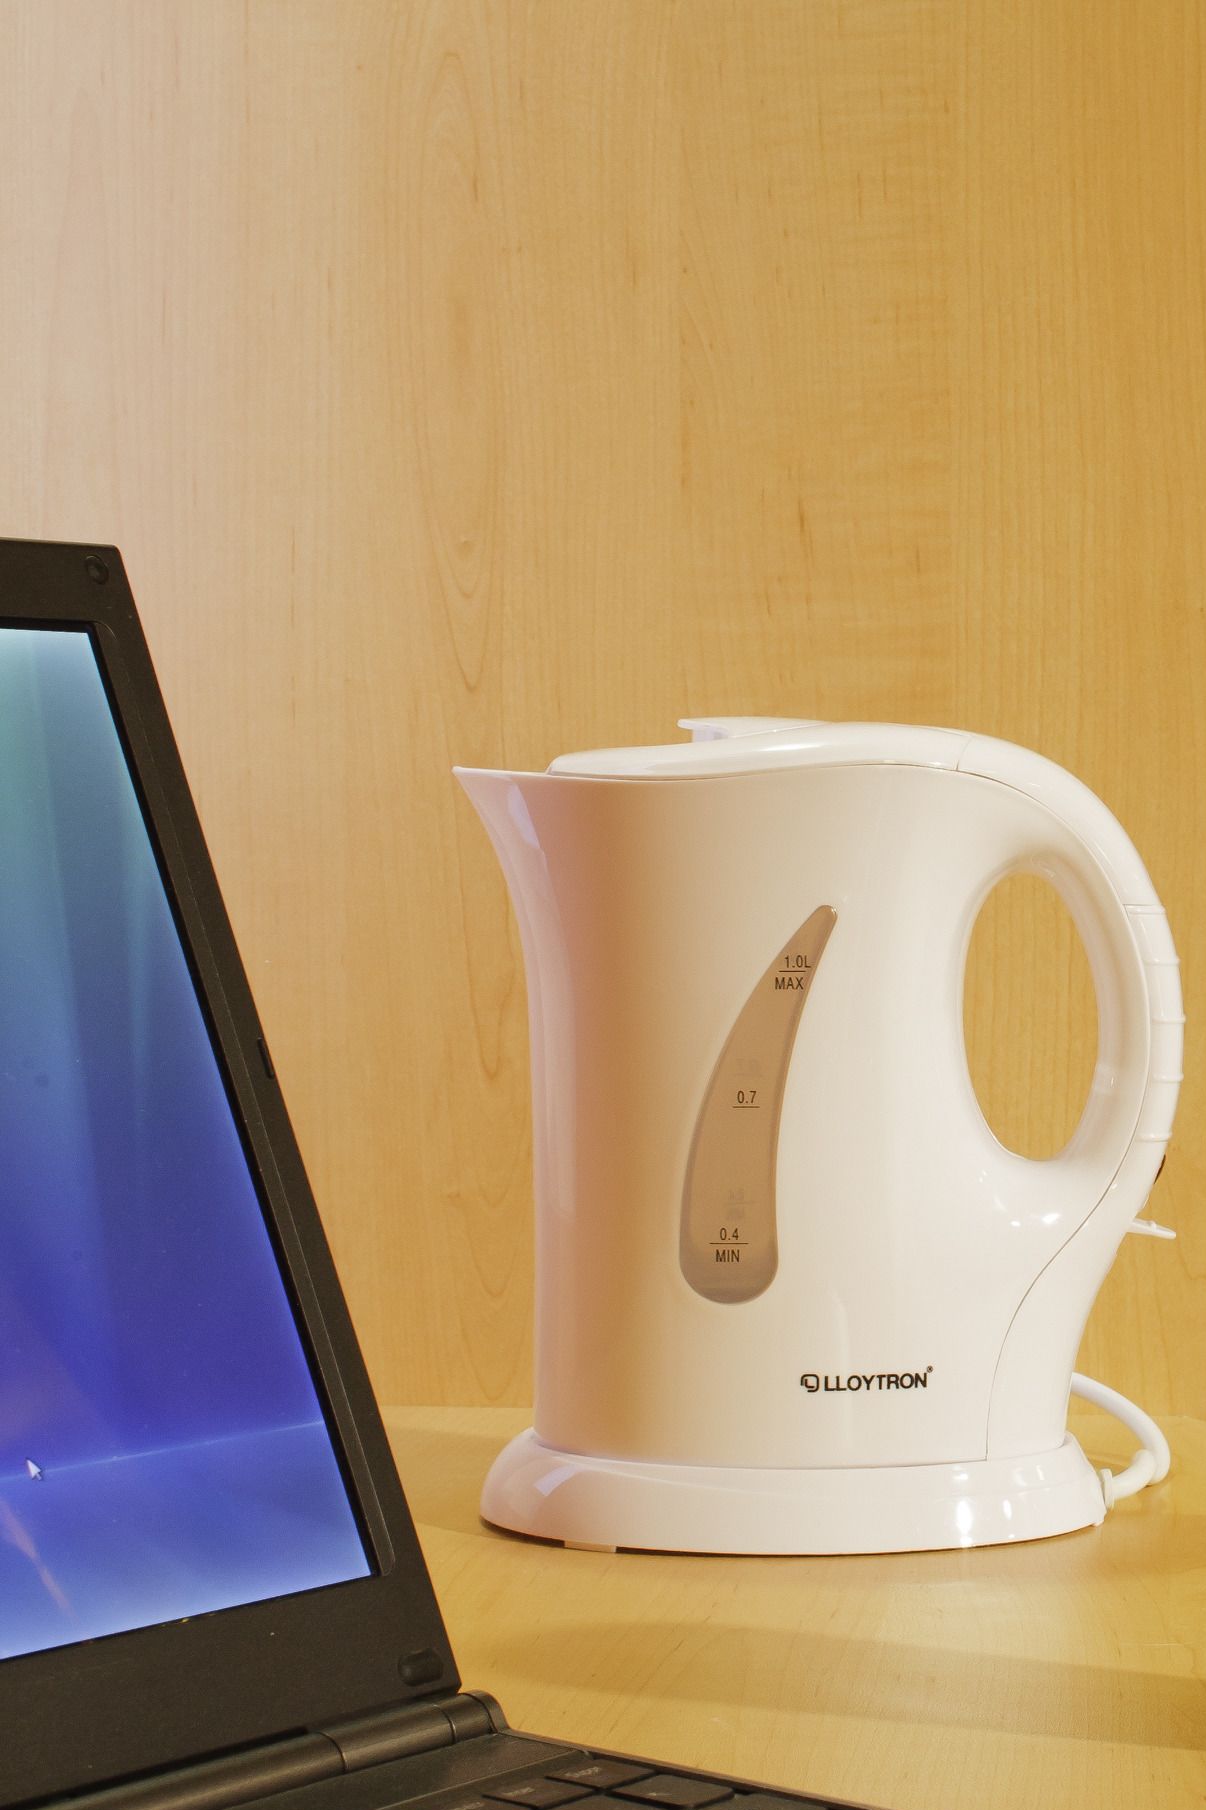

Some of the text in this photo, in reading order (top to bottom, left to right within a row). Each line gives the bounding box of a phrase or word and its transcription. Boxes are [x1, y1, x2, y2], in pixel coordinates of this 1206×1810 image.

[784, 955, 812, 969] 1.0L
[774, 976, 805, 991] MAX
[736, 1090, 758, 1104] 0.7
[719, 1228, 740, 1242] 0.4
[715, 1248, 741, 1263] MIN
